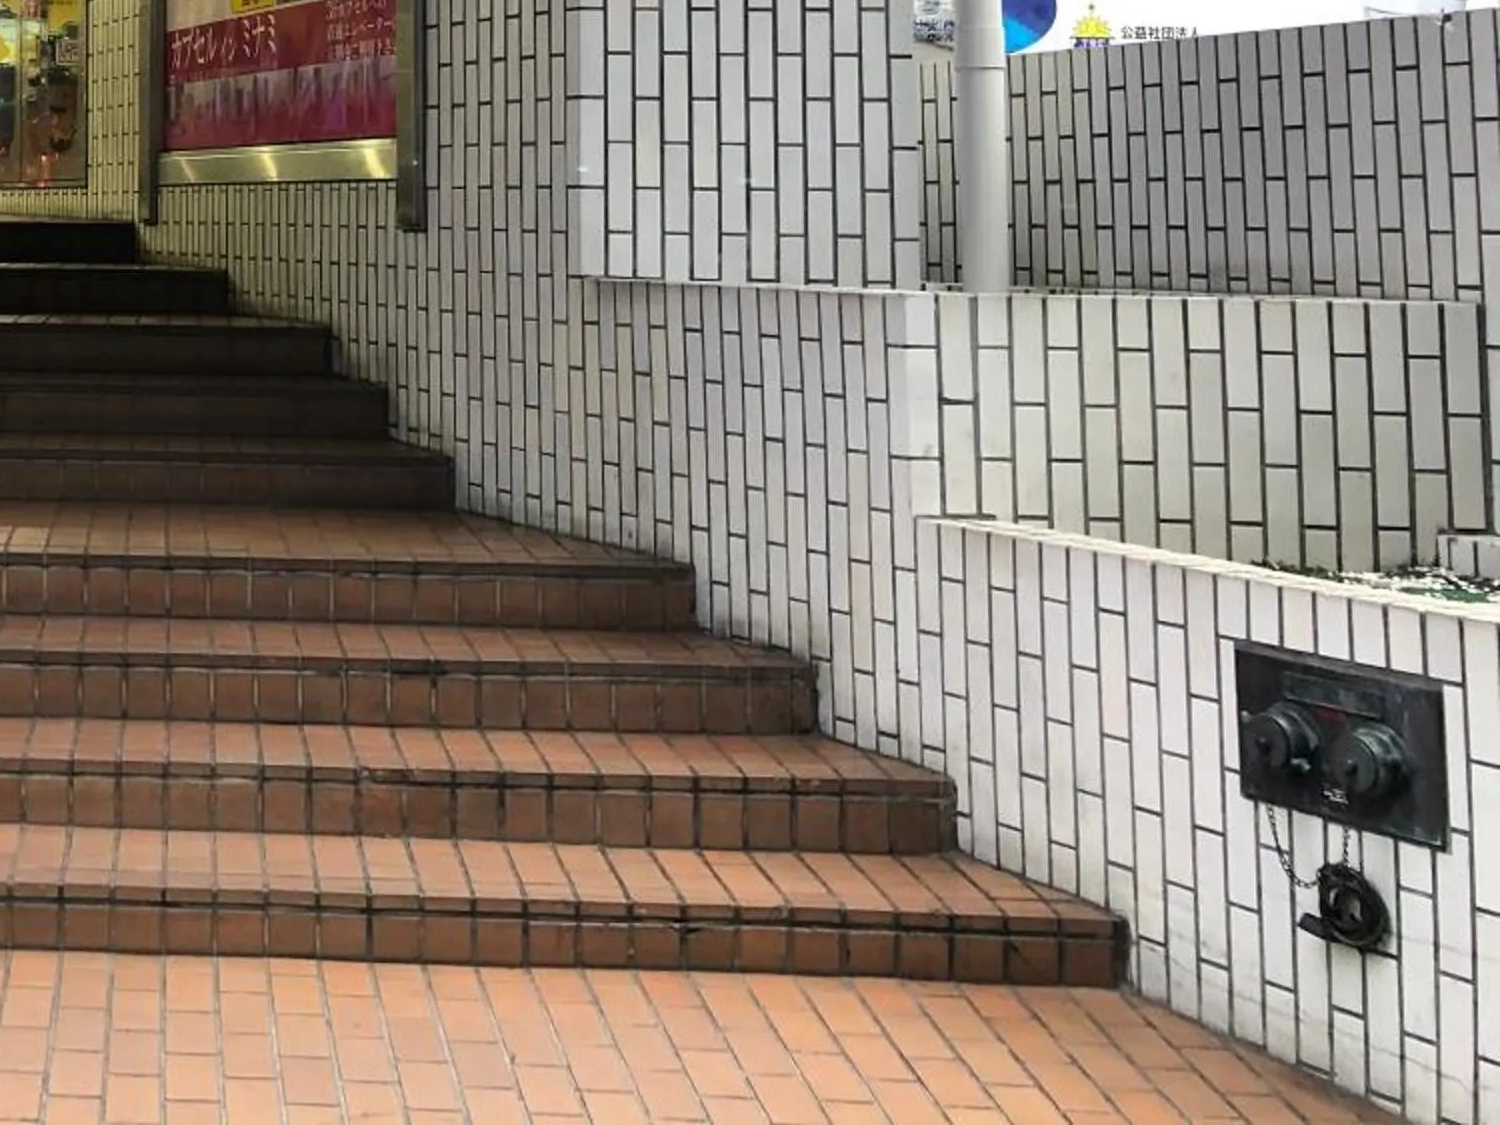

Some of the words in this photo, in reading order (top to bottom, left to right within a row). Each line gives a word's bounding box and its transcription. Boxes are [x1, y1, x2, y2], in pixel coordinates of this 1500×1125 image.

[171, 28, 216, 70] カプセル
[242, 13, 278, 59] ミナミ
[1121, 26, 1199, 41] 公益社団法人
